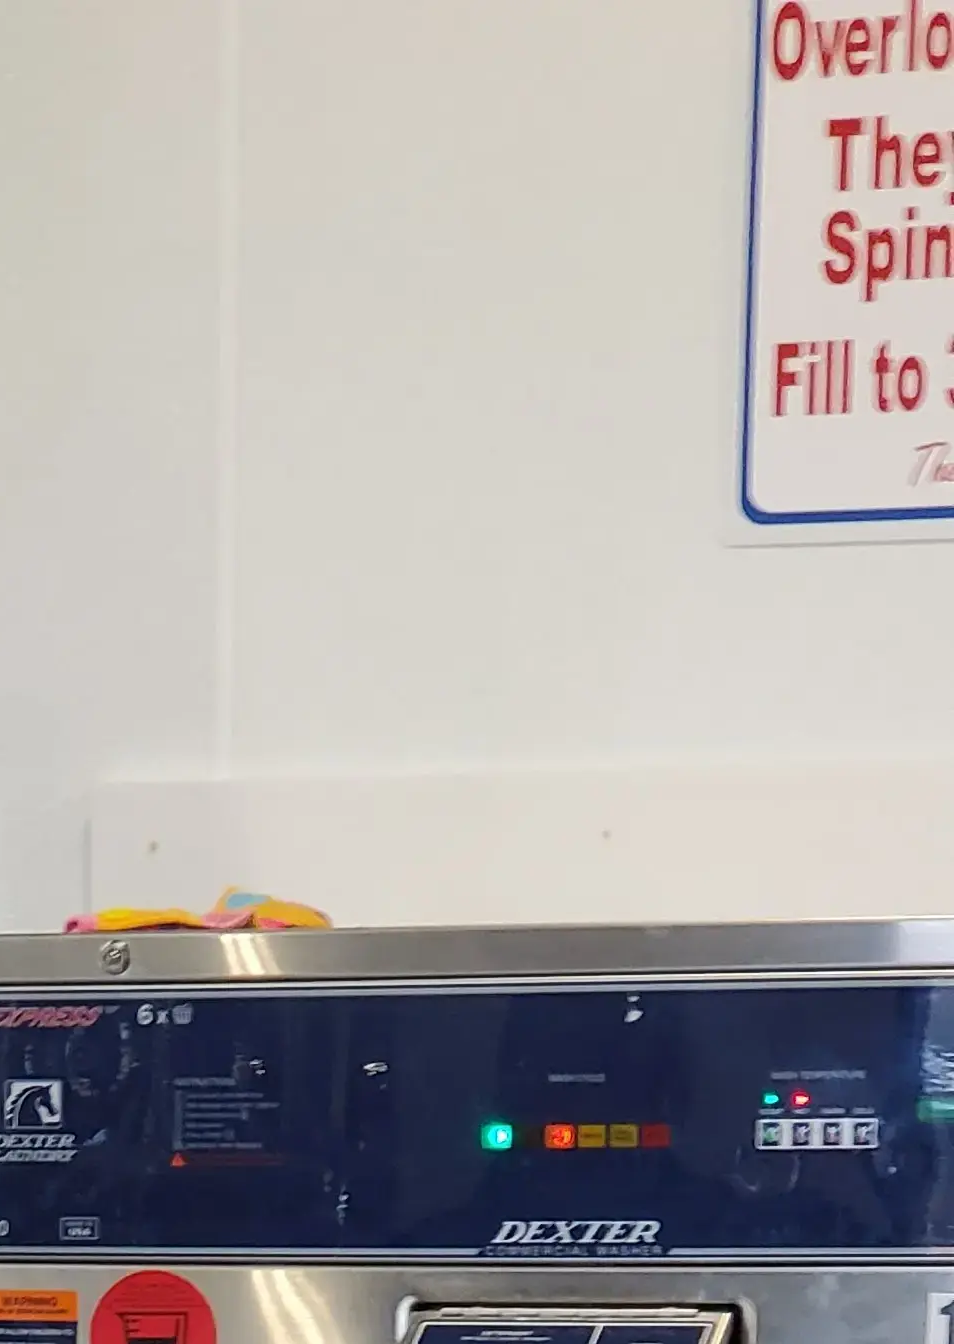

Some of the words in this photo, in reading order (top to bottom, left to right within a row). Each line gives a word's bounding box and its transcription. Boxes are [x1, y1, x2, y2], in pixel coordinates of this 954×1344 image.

[772, 0, 954, 81] Overlo
[823, 207, 954, 302] Spin
[771, 339, 852, 416] Fill
[873, 342, 925, 412] to
[136, 1004, 154, 1025] 6
[489, 1220, 662, 1244] DEXTER
